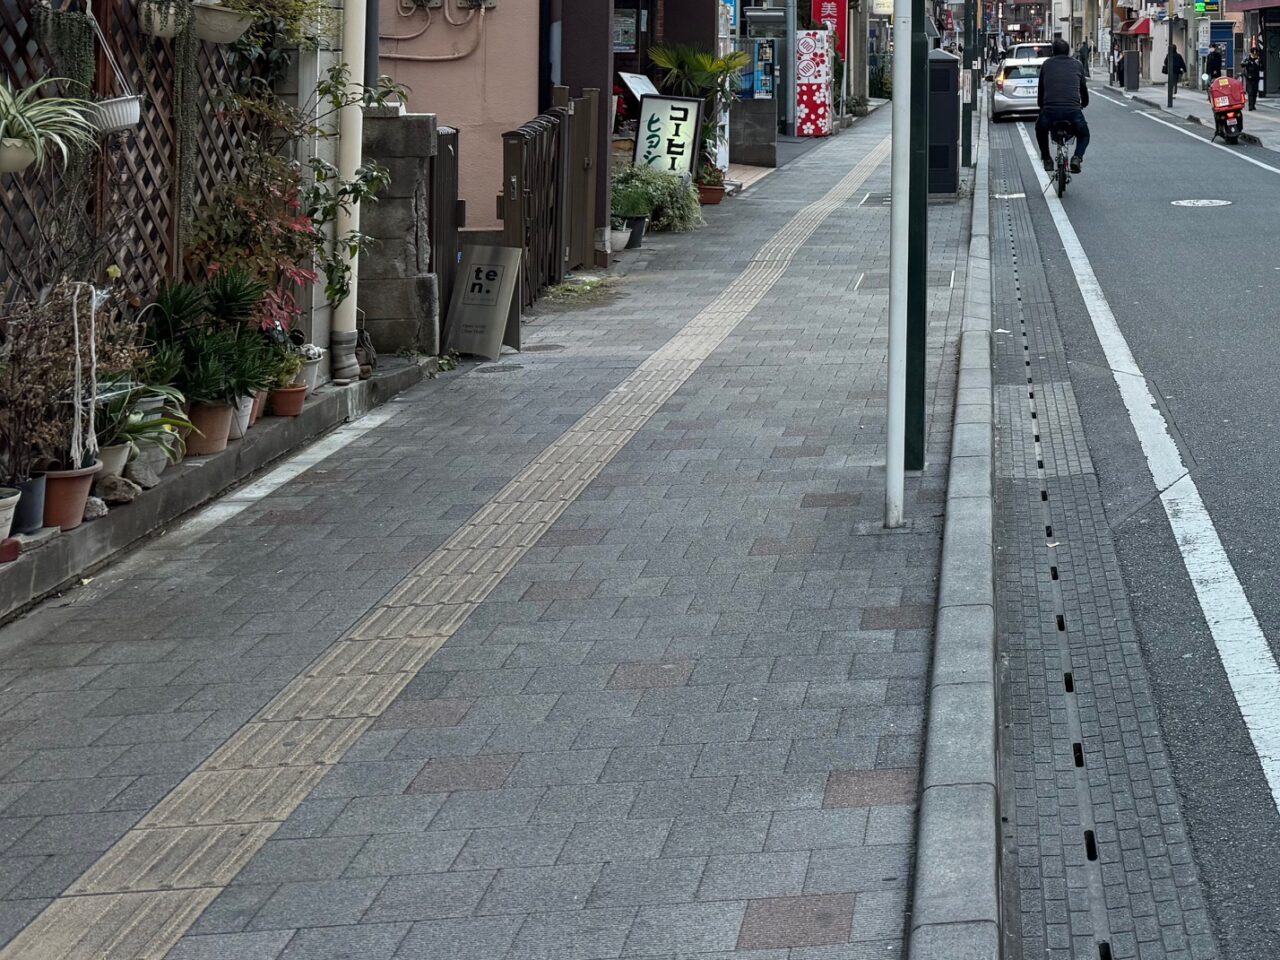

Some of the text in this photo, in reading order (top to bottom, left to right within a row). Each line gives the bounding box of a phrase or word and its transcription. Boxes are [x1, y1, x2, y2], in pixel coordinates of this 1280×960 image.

[643, 113, 661, 165] ヒヨシ
[666, 104, 689, 171] コーヒー
